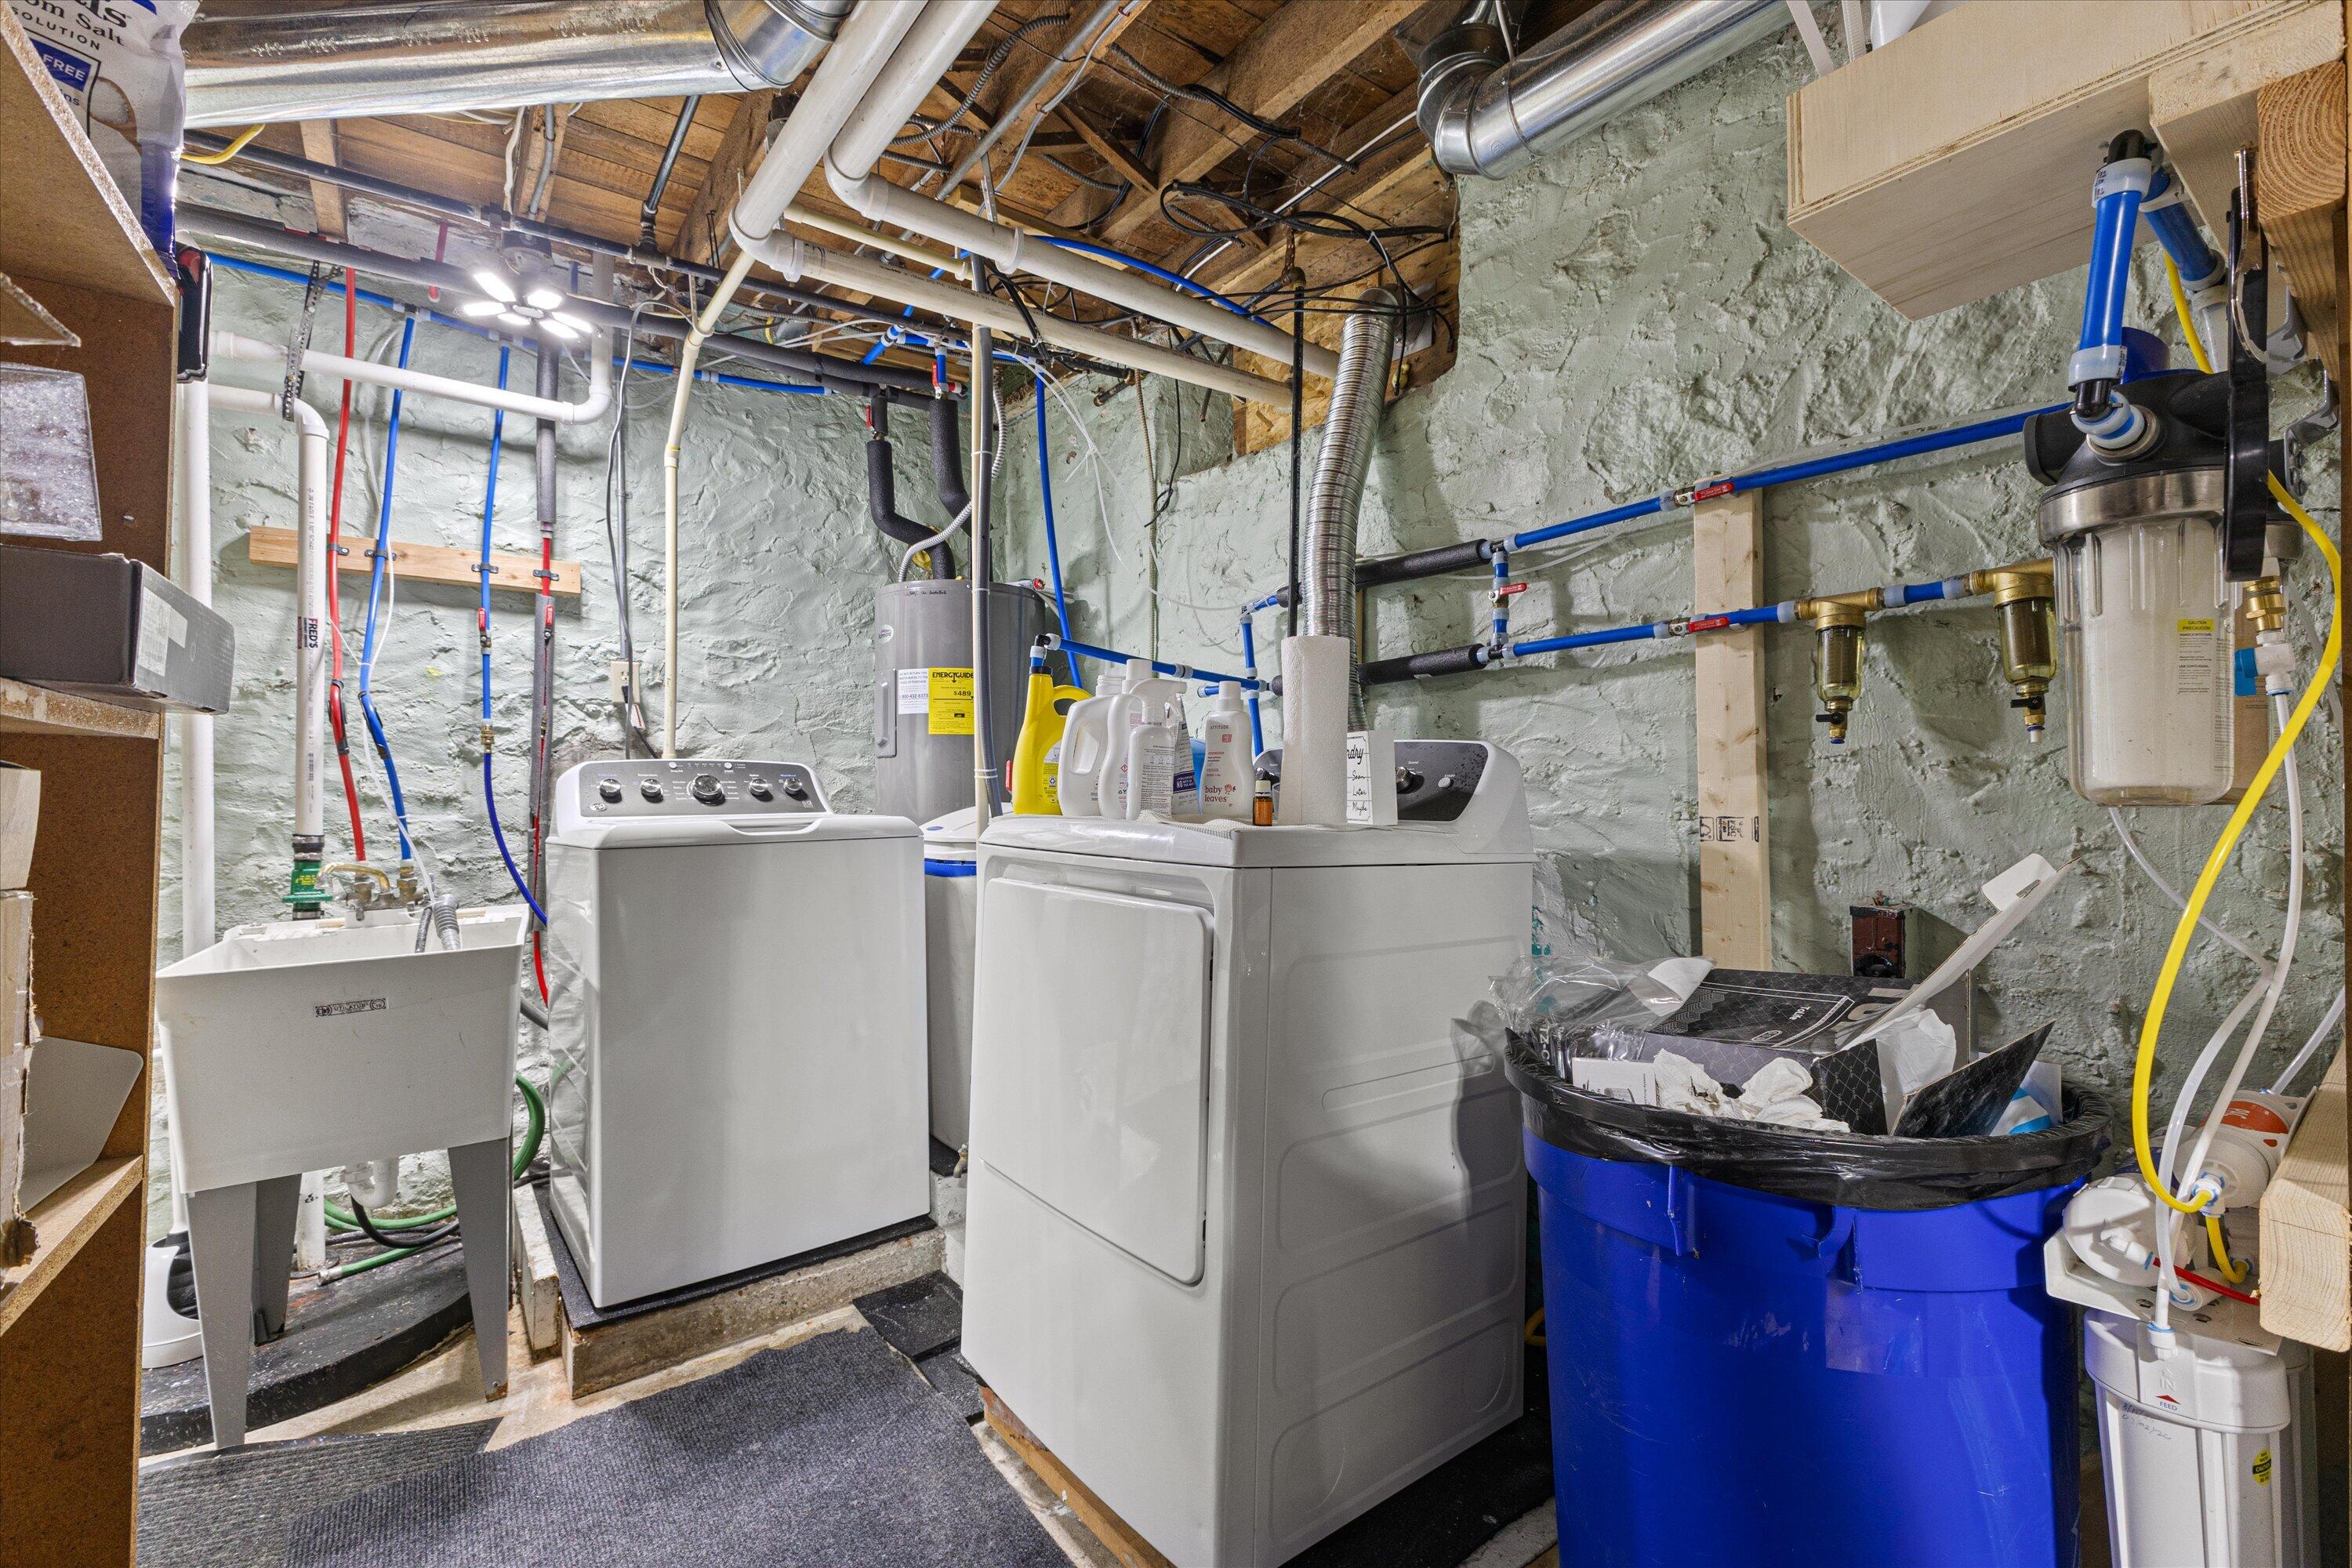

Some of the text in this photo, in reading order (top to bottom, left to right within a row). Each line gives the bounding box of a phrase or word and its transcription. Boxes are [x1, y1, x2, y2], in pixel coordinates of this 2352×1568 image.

[12, 6, 100, 51] SOLUTION
[76, 13, 124, 46] Salt
[43, 53, 86, 82] FREE
[307, 618, 319, 648] FRED'S
[1352, 769, 1367, 781] Soon
[1205, 786, 1222, 795] baby
[1352, 786, 1367, 797] Later
[1204, 794, 1227, 803] leaves
[1352, 801, 1368, 816] Maybe
[2159, 1401, 2178, 1411] FEED
